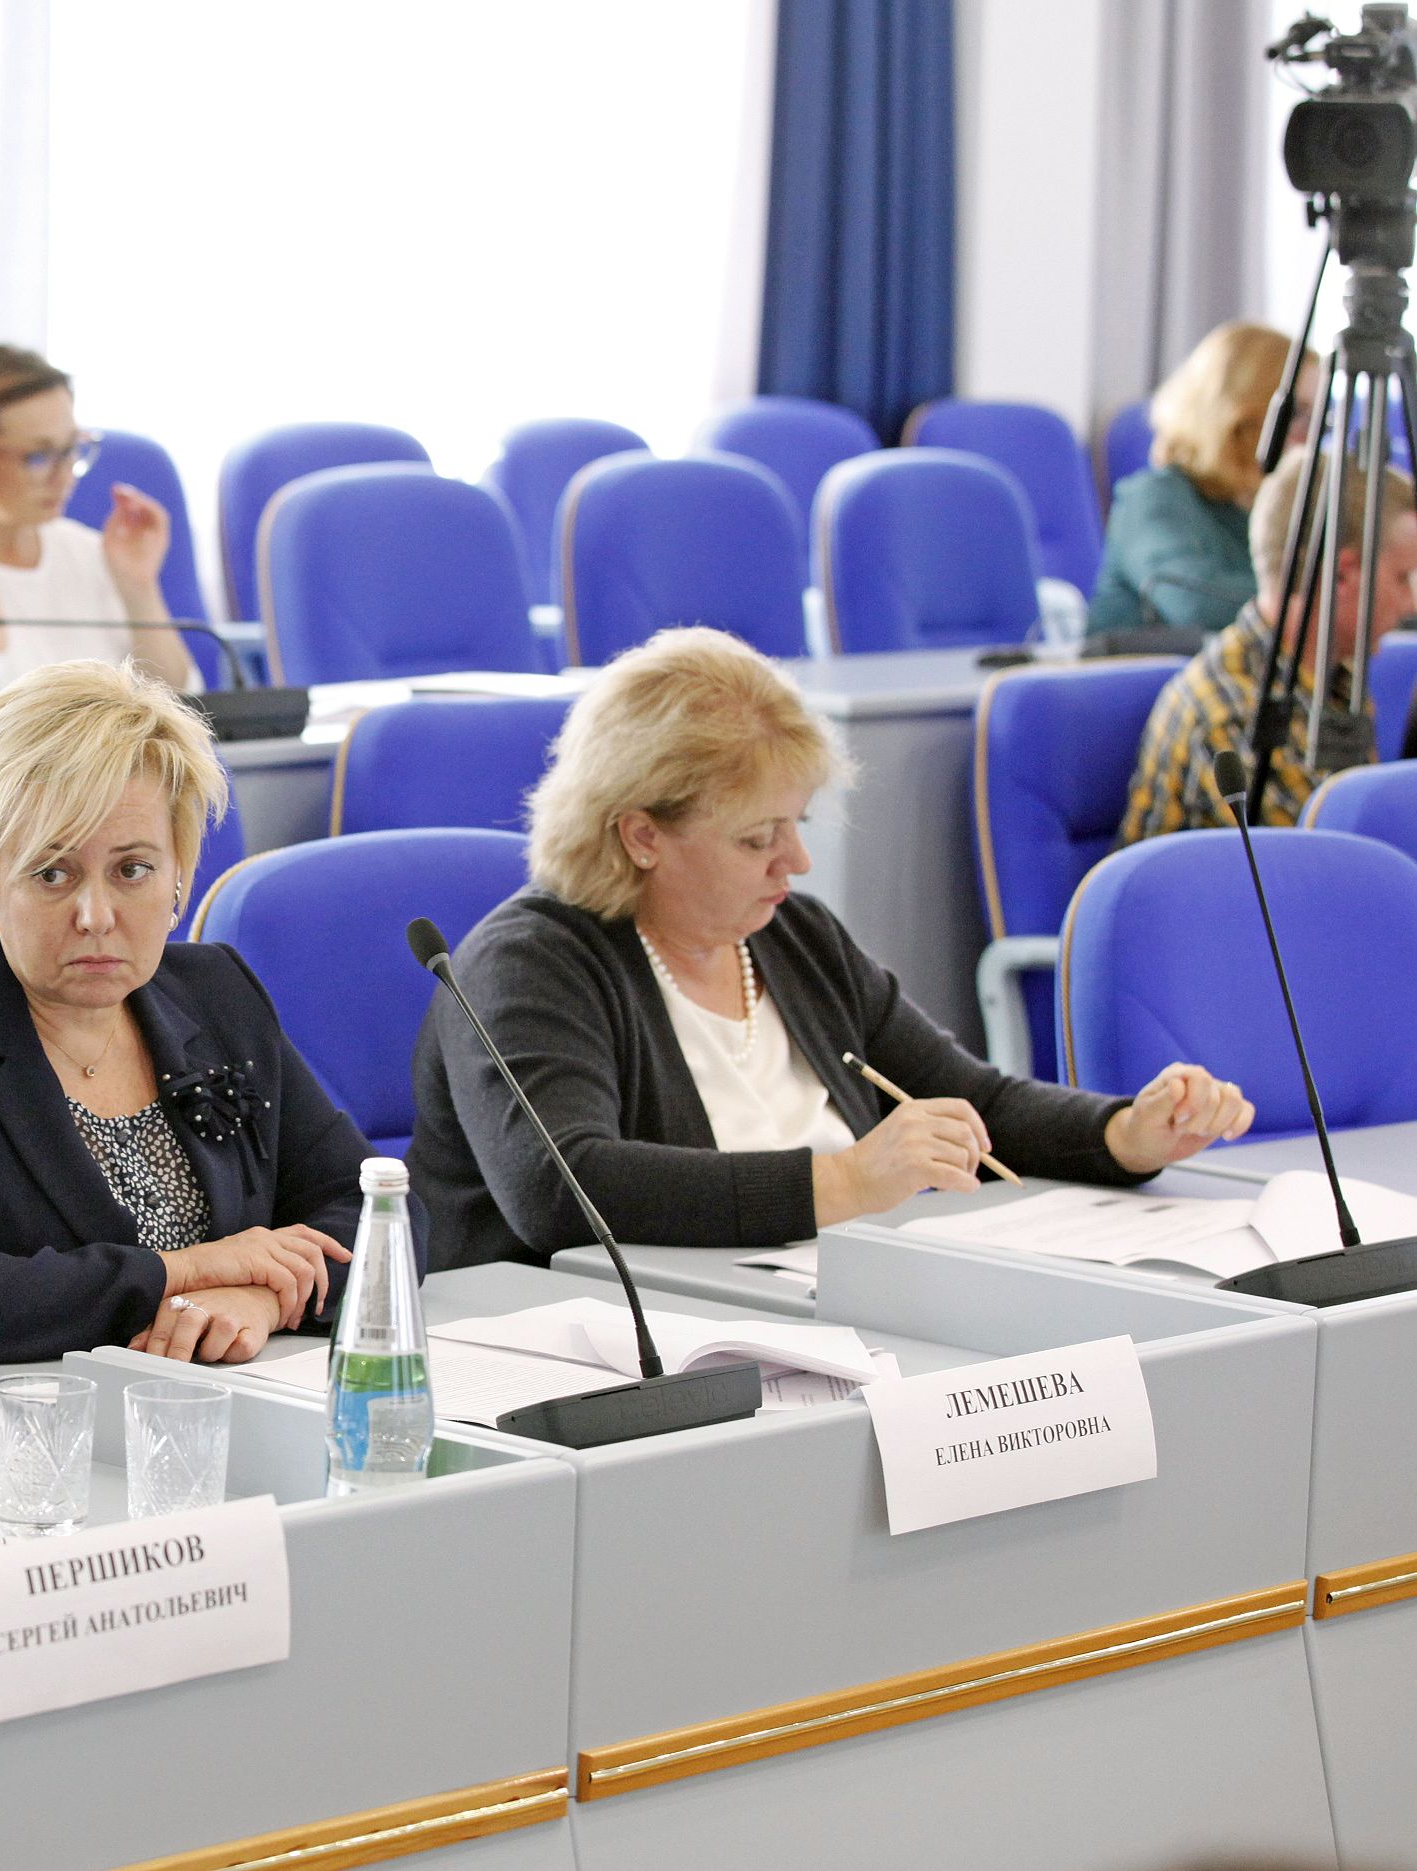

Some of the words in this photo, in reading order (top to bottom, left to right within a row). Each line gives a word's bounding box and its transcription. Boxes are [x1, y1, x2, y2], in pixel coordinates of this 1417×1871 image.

[945, 1370, 1085, 1419] ЛЕМЕШЕВА
[935, 1435, 994, 1466] ЕЛЕНА
[997, 1415, 1112, 1454] ВИКТОРОВНА
[24, 1534, 206, 1596] ПЕРШИКОВ
[84, 1582, 248, 1635] АНАТОЛЬЕВИЧ
